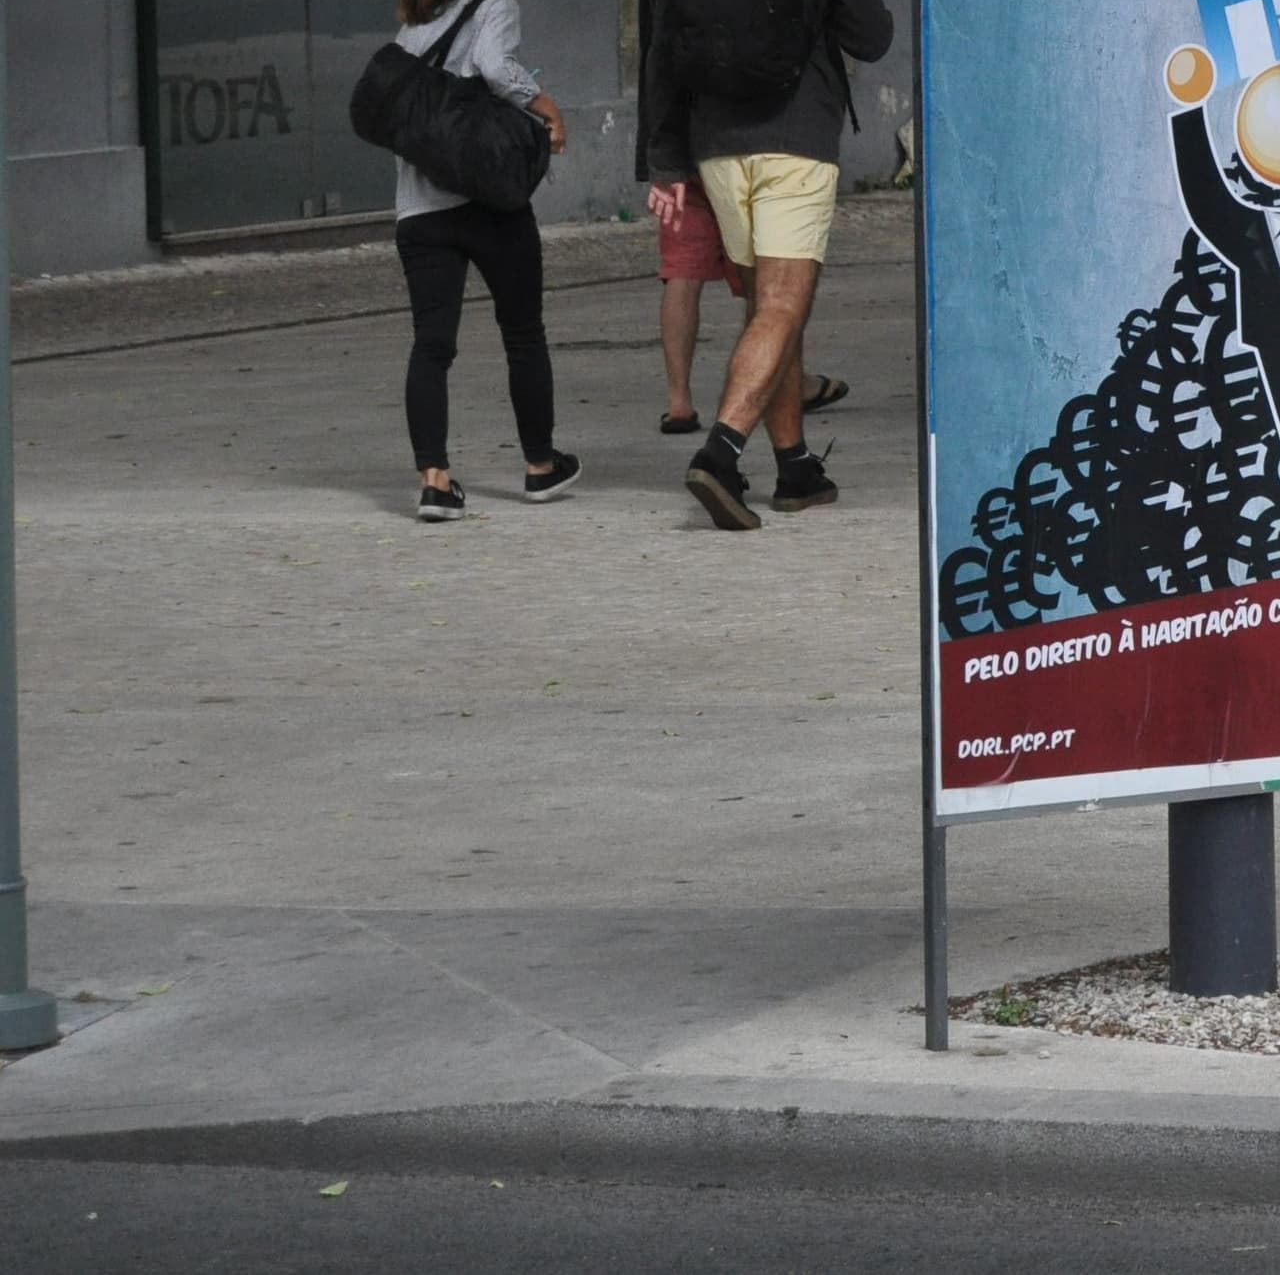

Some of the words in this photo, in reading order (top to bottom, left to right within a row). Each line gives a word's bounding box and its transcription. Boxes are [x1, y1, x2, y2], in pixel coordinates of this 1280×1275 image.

[160, 65, 294, 146] TOFA
[964, 651, 1019, 684] PELO
[1025, 633, 1111, 671] DIREITO
[1118, 619, 1134, 654] À
[1141, 597, 1263, 648] HABITAÇÃO
[957, 729, 1075, 759] DORL.PCP.PT
